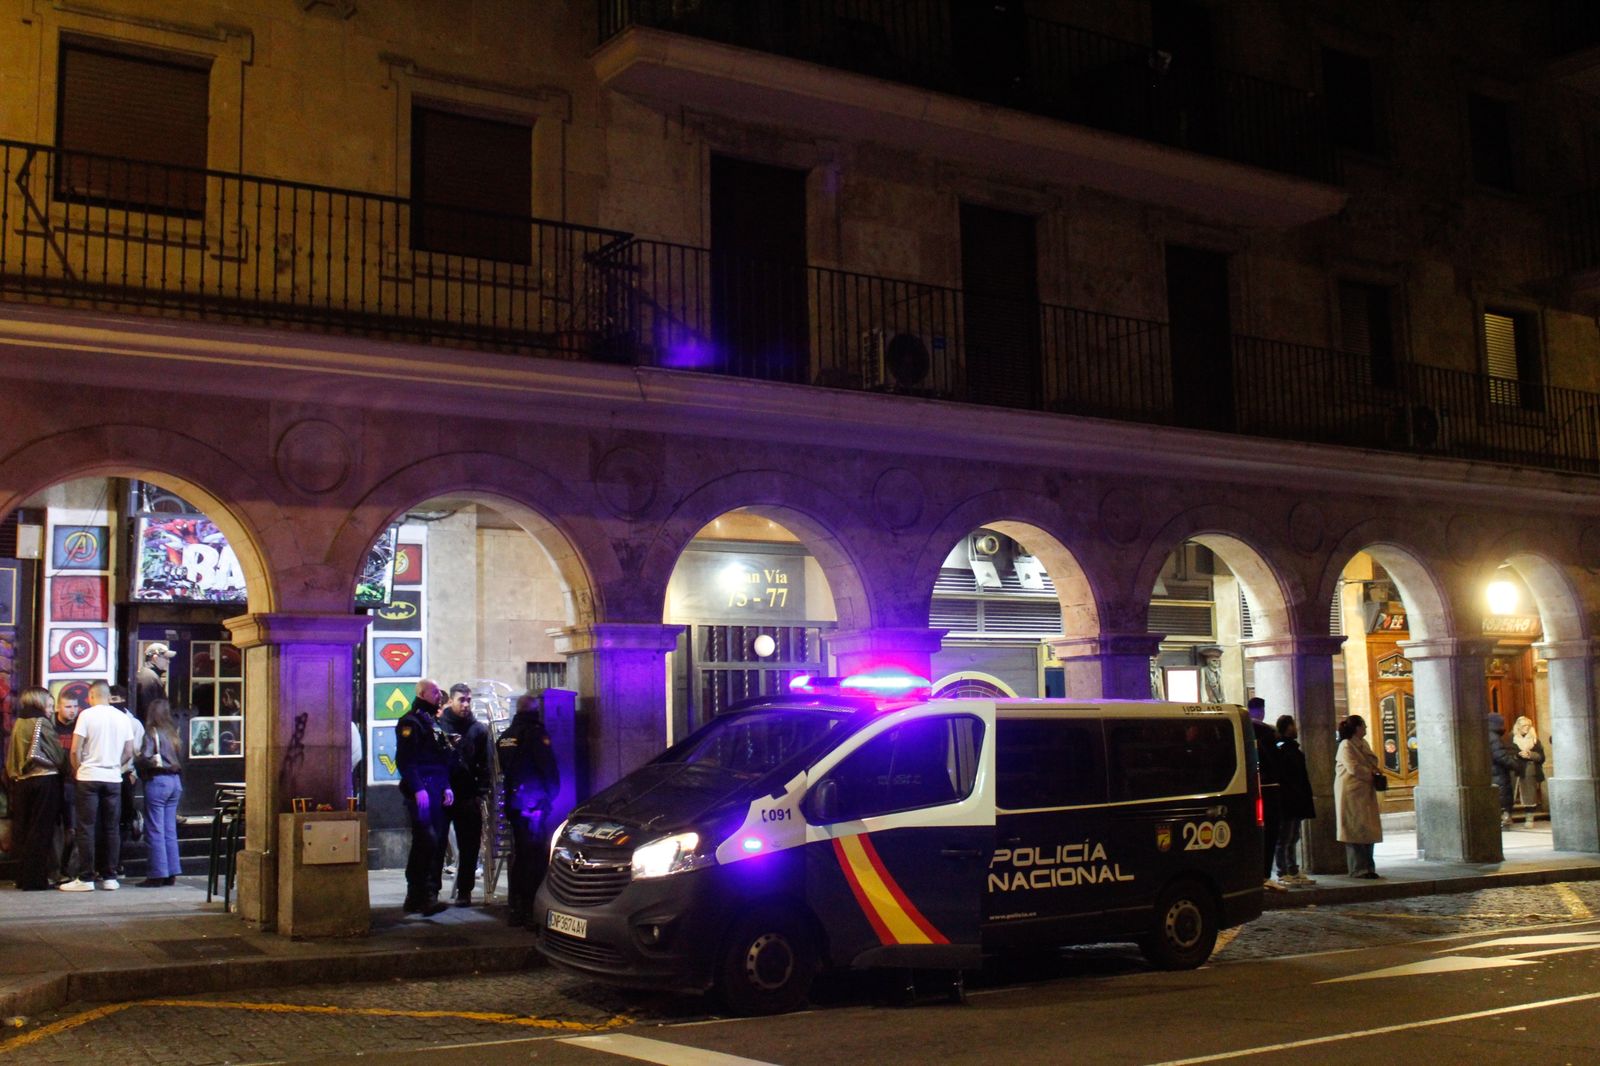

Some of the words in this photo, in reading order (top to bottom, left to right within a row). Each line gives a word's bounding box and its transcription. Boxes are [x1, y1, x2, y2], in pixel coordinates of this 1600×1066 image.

[764, 569, 788, 584] Vía
[766, 588, 788, 608] 77
[768, 808, 792, 821] 091
[1182, 820, 1231, 851] 200
[988, 838, 1108, 869] POLICÍA
[987, 863, 1135, 893] NACIONAL
